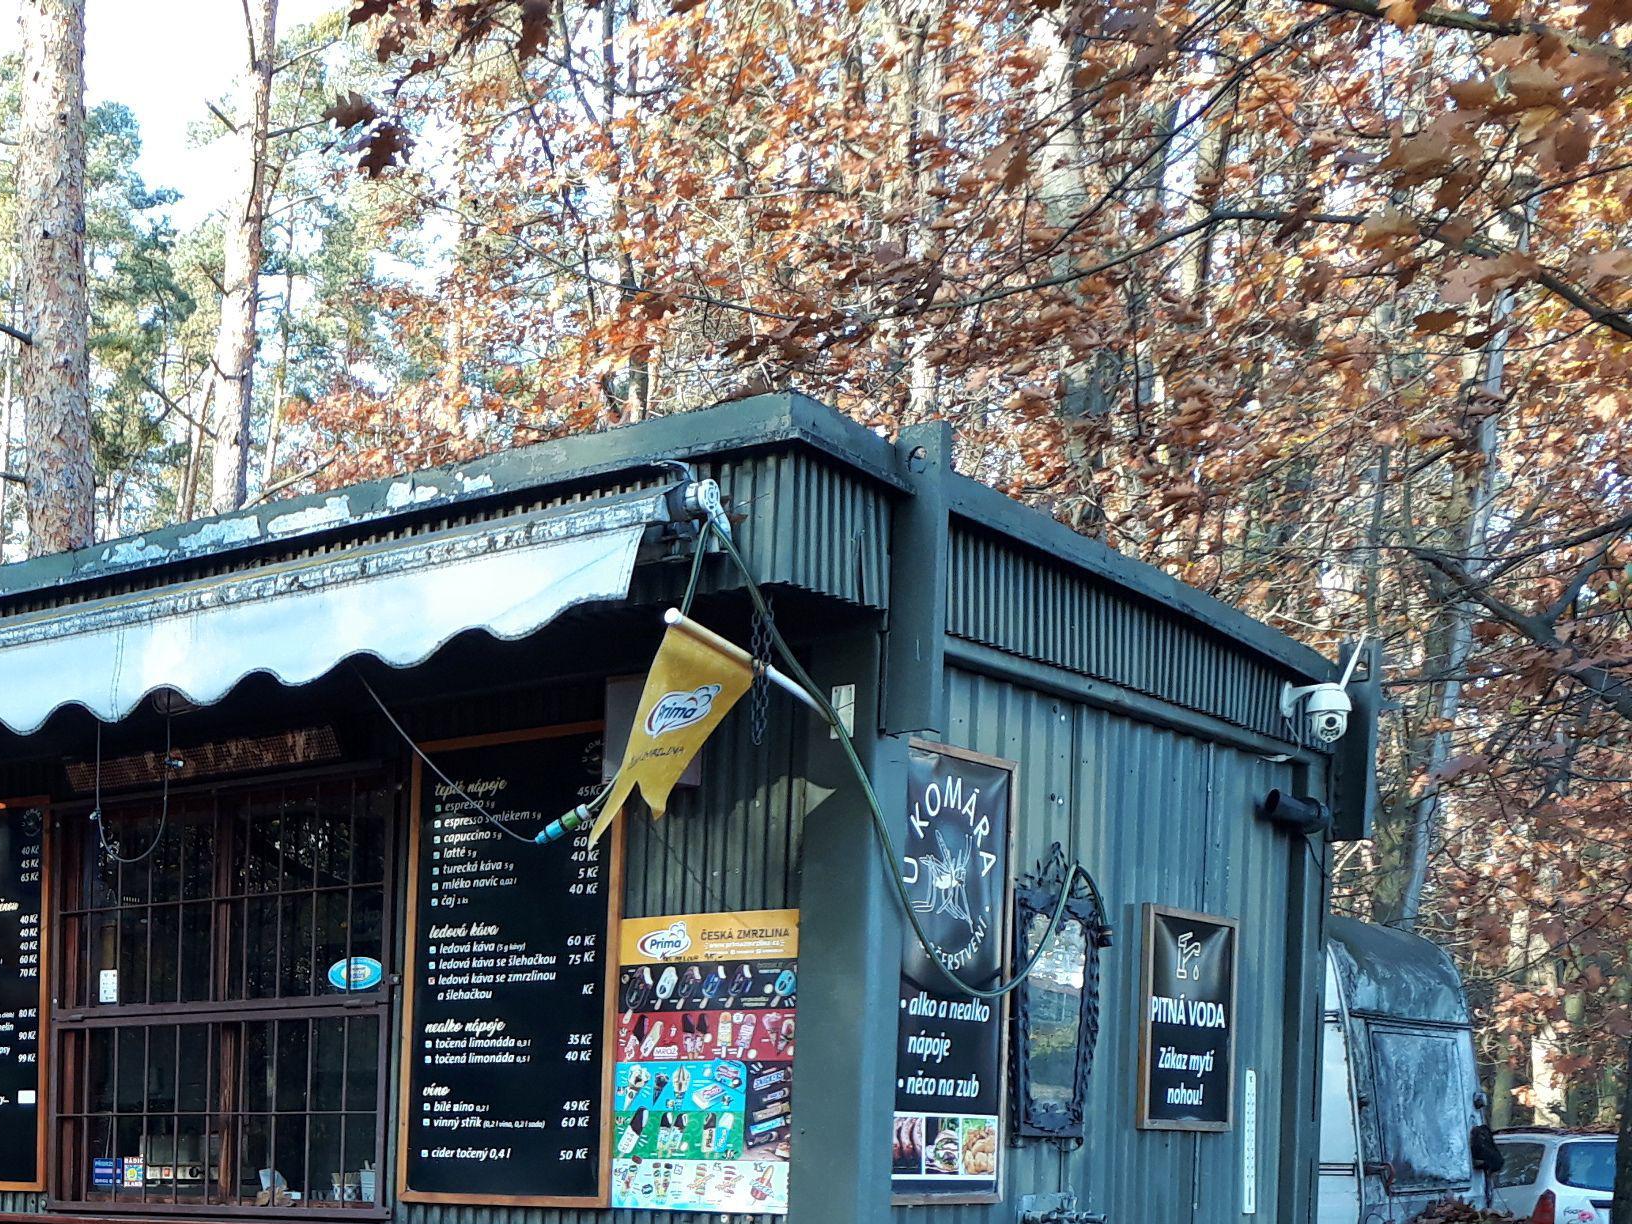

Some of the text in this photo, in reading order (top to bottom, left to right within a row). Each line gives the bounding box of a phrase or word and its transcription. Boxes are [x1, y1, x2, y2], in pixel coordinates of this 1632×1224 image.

[655, 702, 697, 721] Prima
[468, 777, 508, 796] nápoje
[576, 787, 589, 797] 45
[445, 800, 483, 813] espresso
[444, 810, 530, 829] espresso mlékem
[903, 775, 997, 884] U KOMÁRA
[443, 831, 491, 846] capuccino
[573, 837, 587, 847] 60
[21, 845, 39, 855] 40 Kč
[443, 847, 466, 859] latté
[571, 849, 600, 861] 40 Kč
[21, 859, 39, 868] 45 Kč
[443, 859, 502, 875] turecká káva
[20, 872, 39, 882] 65 Kč
[578, 866, 599, 879] 5 Kč
[441, 875, 498, 890] mléko navíc
[569, 882, 598, 894] 40 Kč
[441, 894, 456, 908] čaj
[20, 914, 38, 924] 40 Kč
[20, 927, 38, 937] 40 Kč
[429, 921, 499, 939] ledová káva
[701, 928, 790, 940] ČESKÁ ZMRZLINA
[19, 941, 38, 951] 40 Kč
[567, 934, 596, 946] 60 Kč
[649, 938, 682, 949] Prima
[918, 914, 988, 971] ERSTVENÍ
[439, 941, 495, 954] ledová káva
[19, 954, 38, 964] 60 Kč
[438, 954, 557, 970] ledová káva se šlehačkou
[568, 950, 595, 965] 75 Kč
[19, 967, 38, 977] 70 Kč
[438, 970, 556, 985] ledová káva se zmrzlinou
[446, 988, 492, 1000] šlehačkou
[582, 983, 595, 995] Kč
[18, 1009, 27, 1018] 80
[28, 1008, 37, 1017] Kč
[909, 991, 991, 1023] alko a nealko
[1151, 994, 1226, 1028] PITNÁ VODA
[425, 1018, 507, 1037] nealko nápoje
[18, 1031, 36, 1040] 90 Kč
[568, 1033, 593, 1045] 35 Kč
[435, 1036, 515, 1048] točená limonáda
[907, 1030, 952, 1064] nápoje
[18, 1053, 36, 1063] 99 Kč
[434, 1052, 514, 1064] točená limonáda
[565, 1050, 592, 1061] 40 Kč
[1158, 1046, 1215, 1078] Zákaz mytí
[423, 1083, 450, 1096] víno
[906, 1070, 980, 1098] něco na zub
[1167, 1082, 1204, 1106] nohou!
[433, 1101, 451, 1112] bílé
[563, 1100, 590, 1111] 49 Kč
[433, 1116, 482, 1130] vinný střik
[561, 1116, 590, 1127] 60 Kč
[431, 1147, 511, 1161] cider točený 0,4 l
[559, 1147, 588, 1161] 50 Kč
